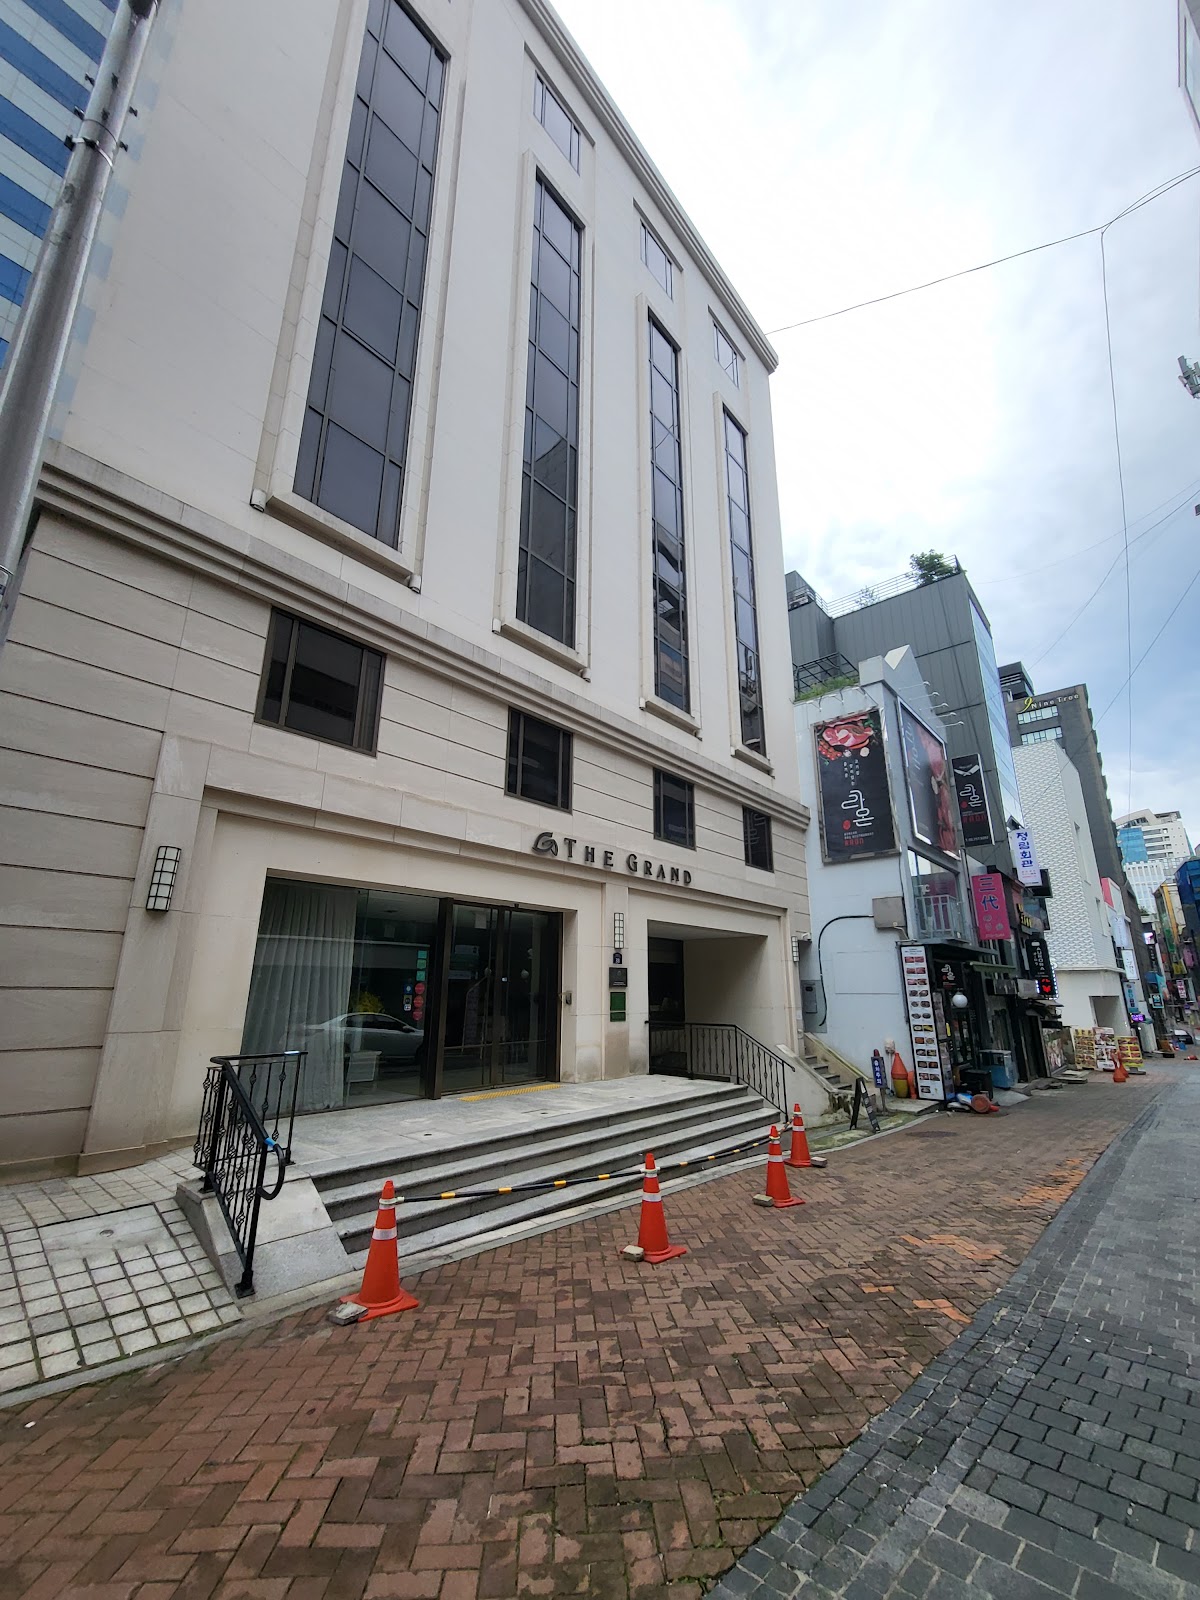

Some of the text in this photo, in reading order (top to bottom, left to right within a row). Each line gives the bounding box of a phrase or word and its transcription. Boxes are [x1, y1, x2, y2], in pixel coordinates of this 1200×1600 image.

[1031, 700, 1055, 709] Nine
[1057, 693, 1079, 703] Tree
[841, 789, 875, 827] 라온
[564, 837, 614, 868] THE
[626, 853, 692, 885] GRAND
[979, 876, 999, 912] 三代
